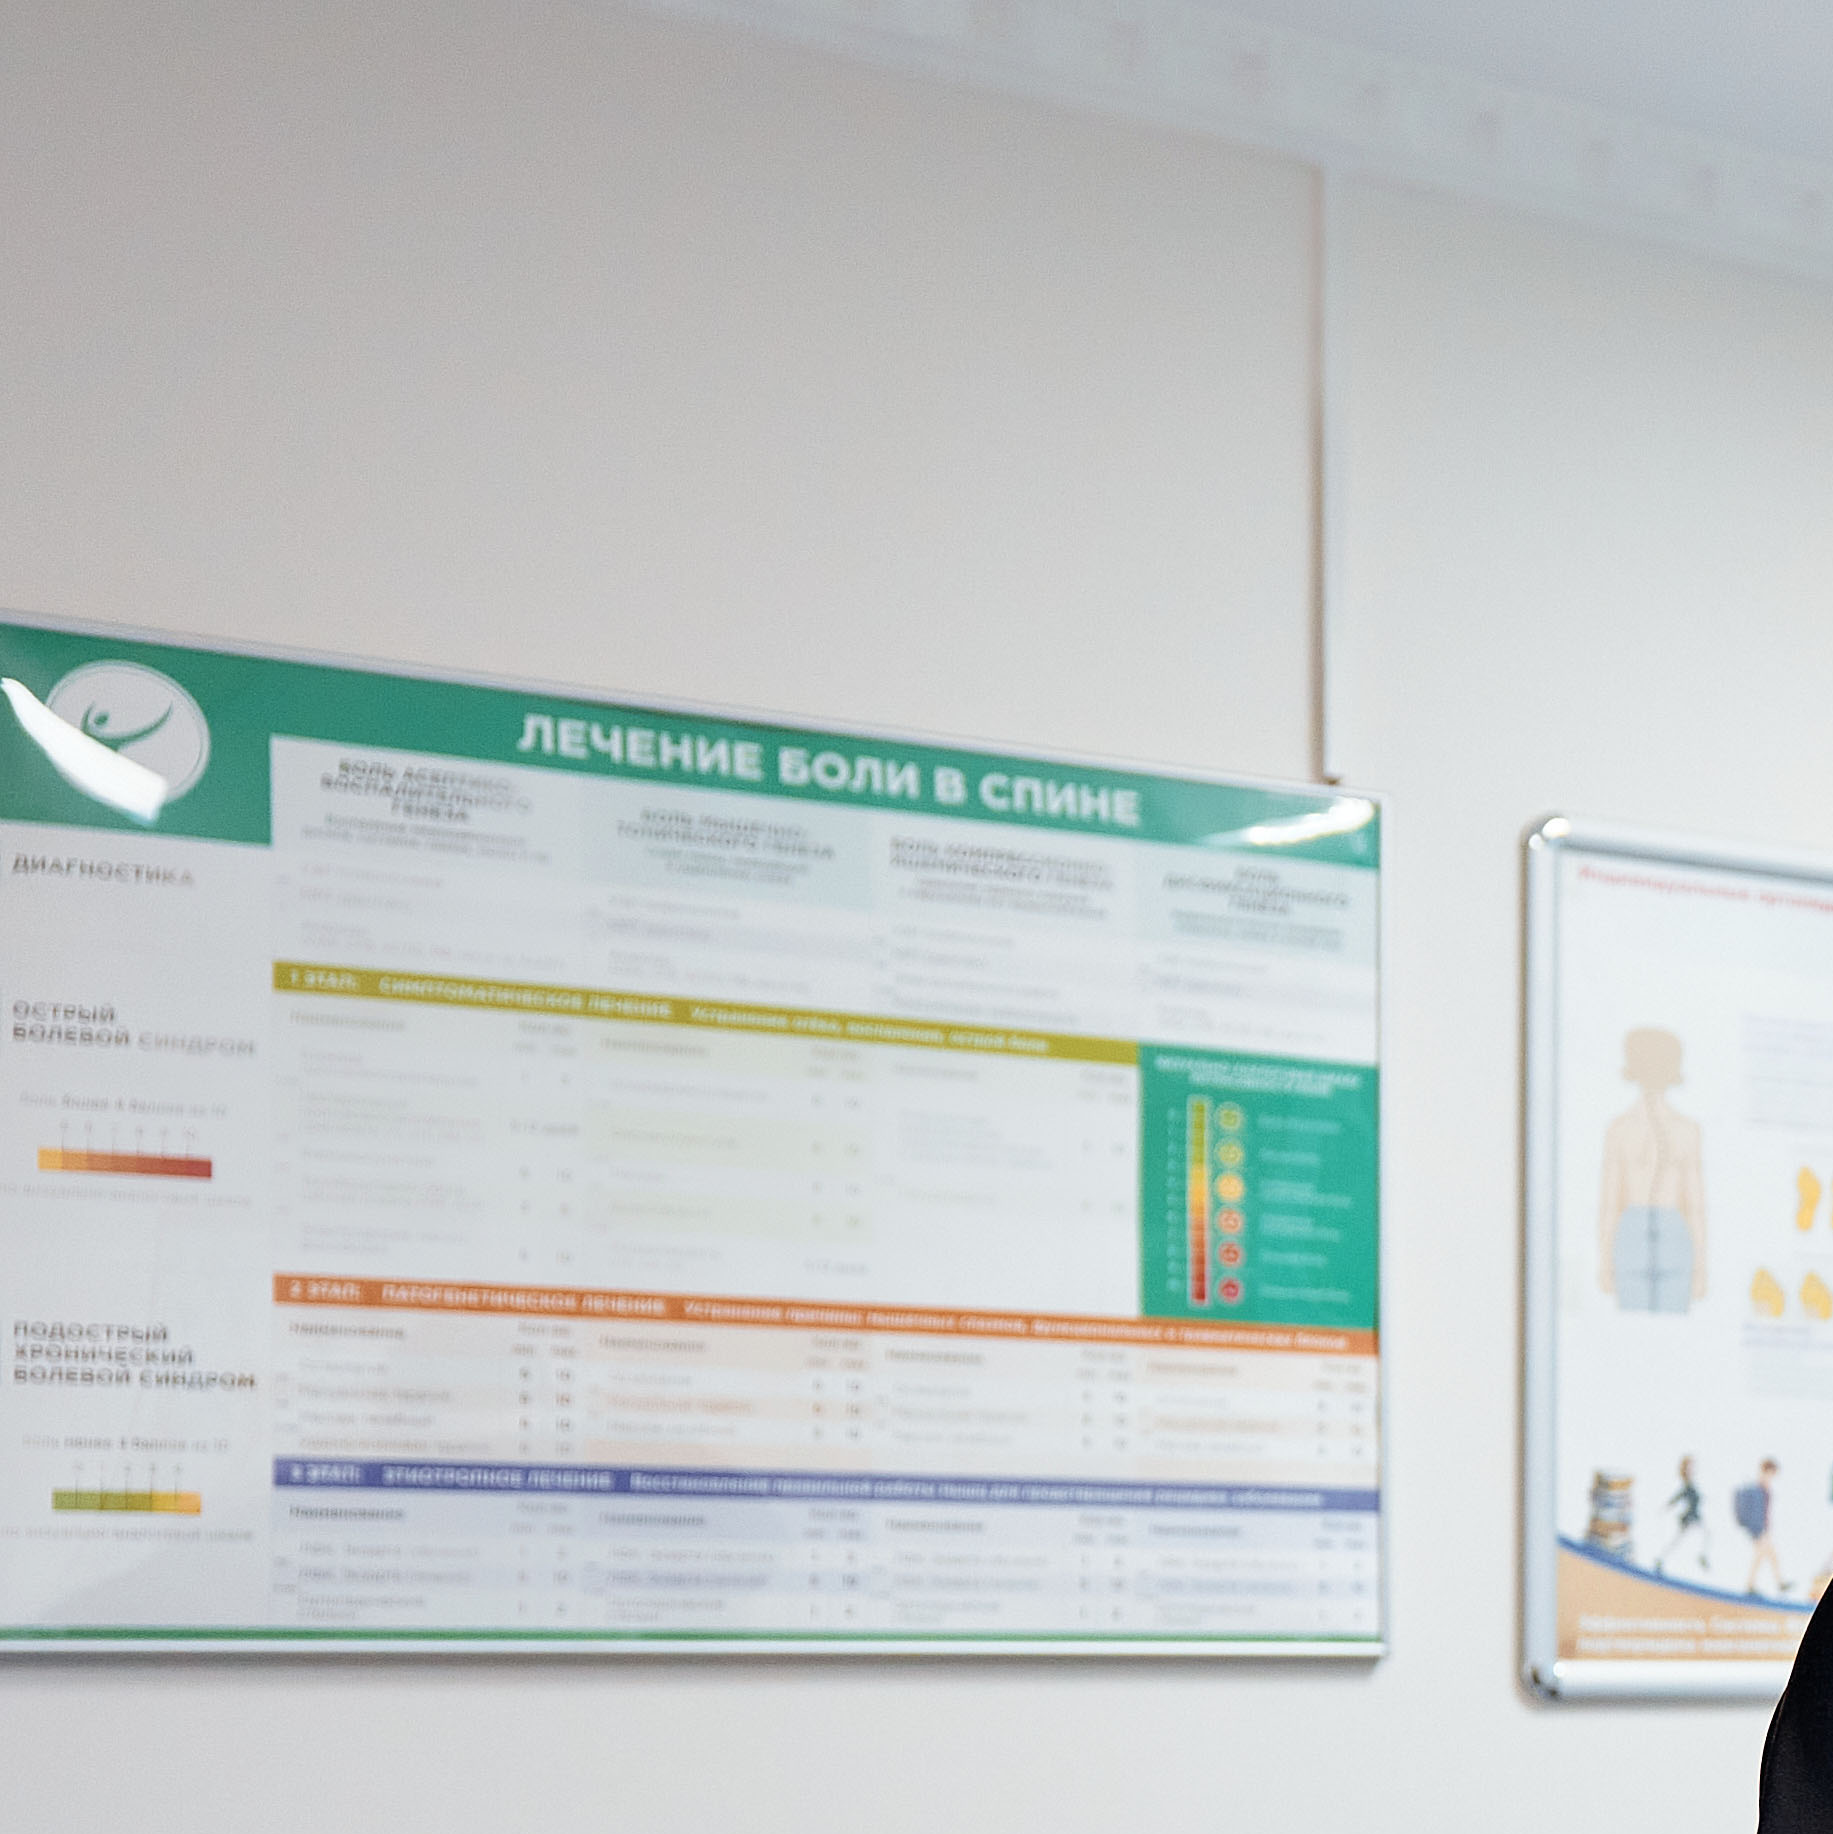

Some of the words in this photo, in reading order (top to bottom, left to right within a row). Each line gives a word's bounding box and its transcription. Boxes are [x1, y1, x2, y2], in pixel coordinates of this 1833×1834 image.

[517, 712, 762, 780] ЛЕЧЕНИЕ
[778, 746, 922, 799] БОЛИ
[934, 764, 968, 804] В
[979, 773, 1140, 827] СПИНЕ
[12, 852, 196, 887] ДИАГНОСТИКА
[12, 999, 118, 1026] ОСТРЫЙ
[12, 1022, 131, 1048] БОЛЕВОЙ
[137, 1030, 257, 1058] СИНДРОМ
[13, 1320, 169, 1344] ПОДОСТРЫЙ
[13, 1344, 195, 1367] ХРОНИЧЕСКИЙ
[12, 1365, 131, 1389] БОЛЕВОЙ
[139, 1369, 258, 1393] СИНДРОМ
